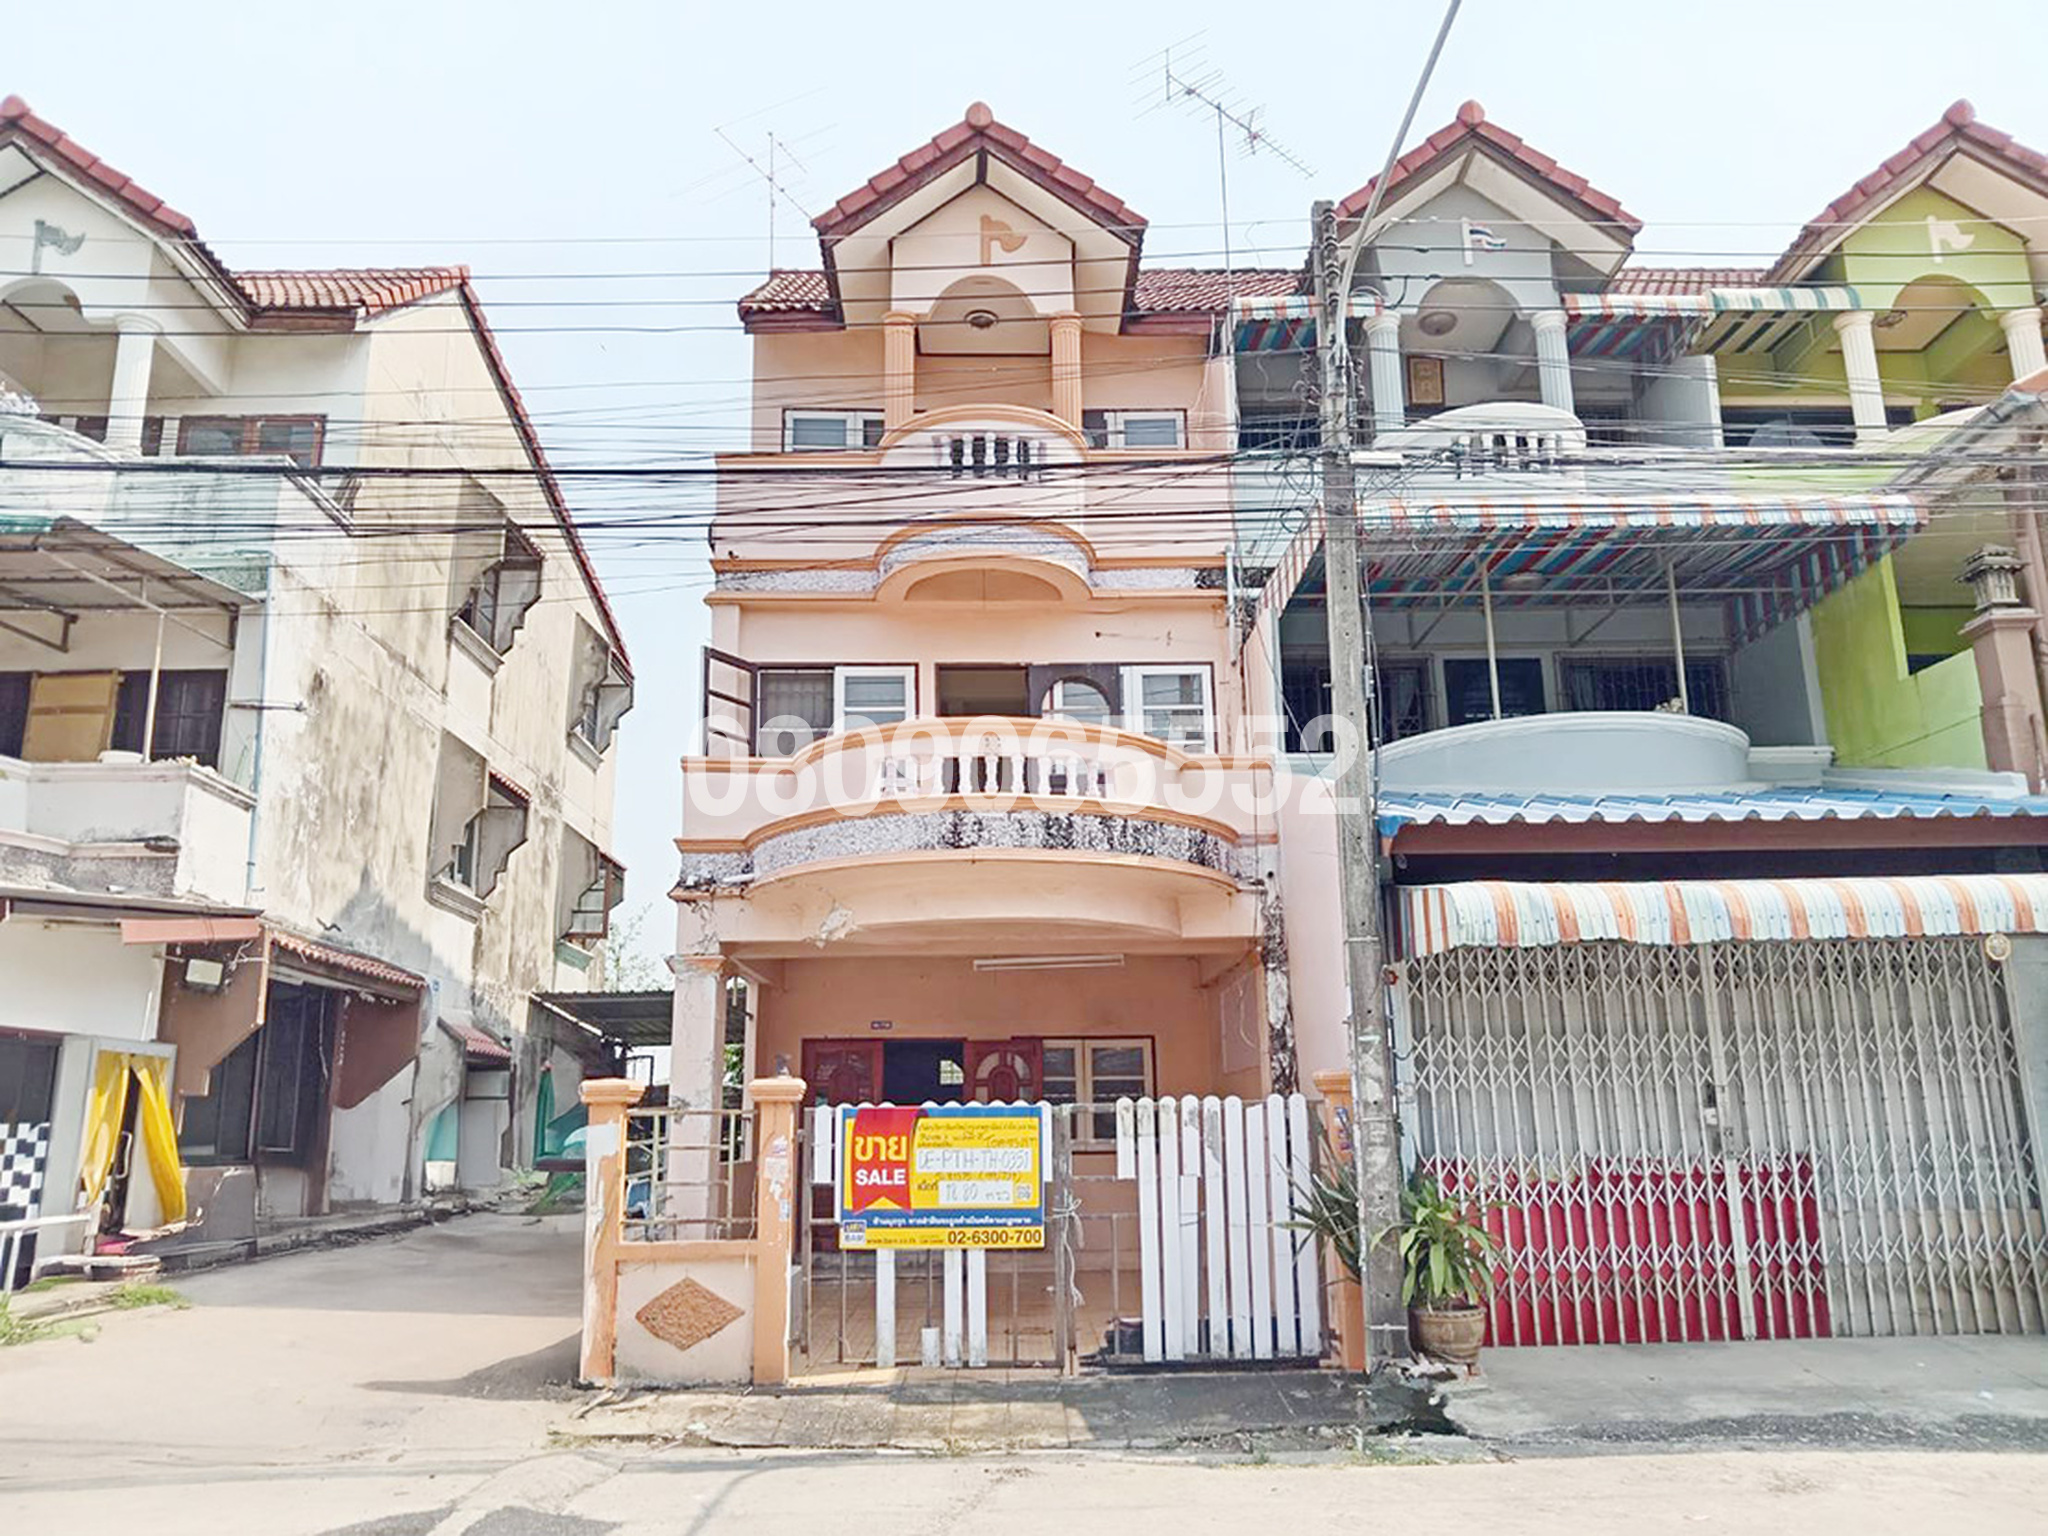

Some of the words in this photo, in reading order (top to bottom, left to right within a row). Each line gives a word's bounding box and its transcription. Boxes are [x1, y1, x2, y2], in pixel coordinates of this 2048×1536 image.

[855, 1136, 907, 1162] ขาย
[855, 1169, 907, 1185] SALE
[948, 1230, 1042, 1244] 02-6300-700
